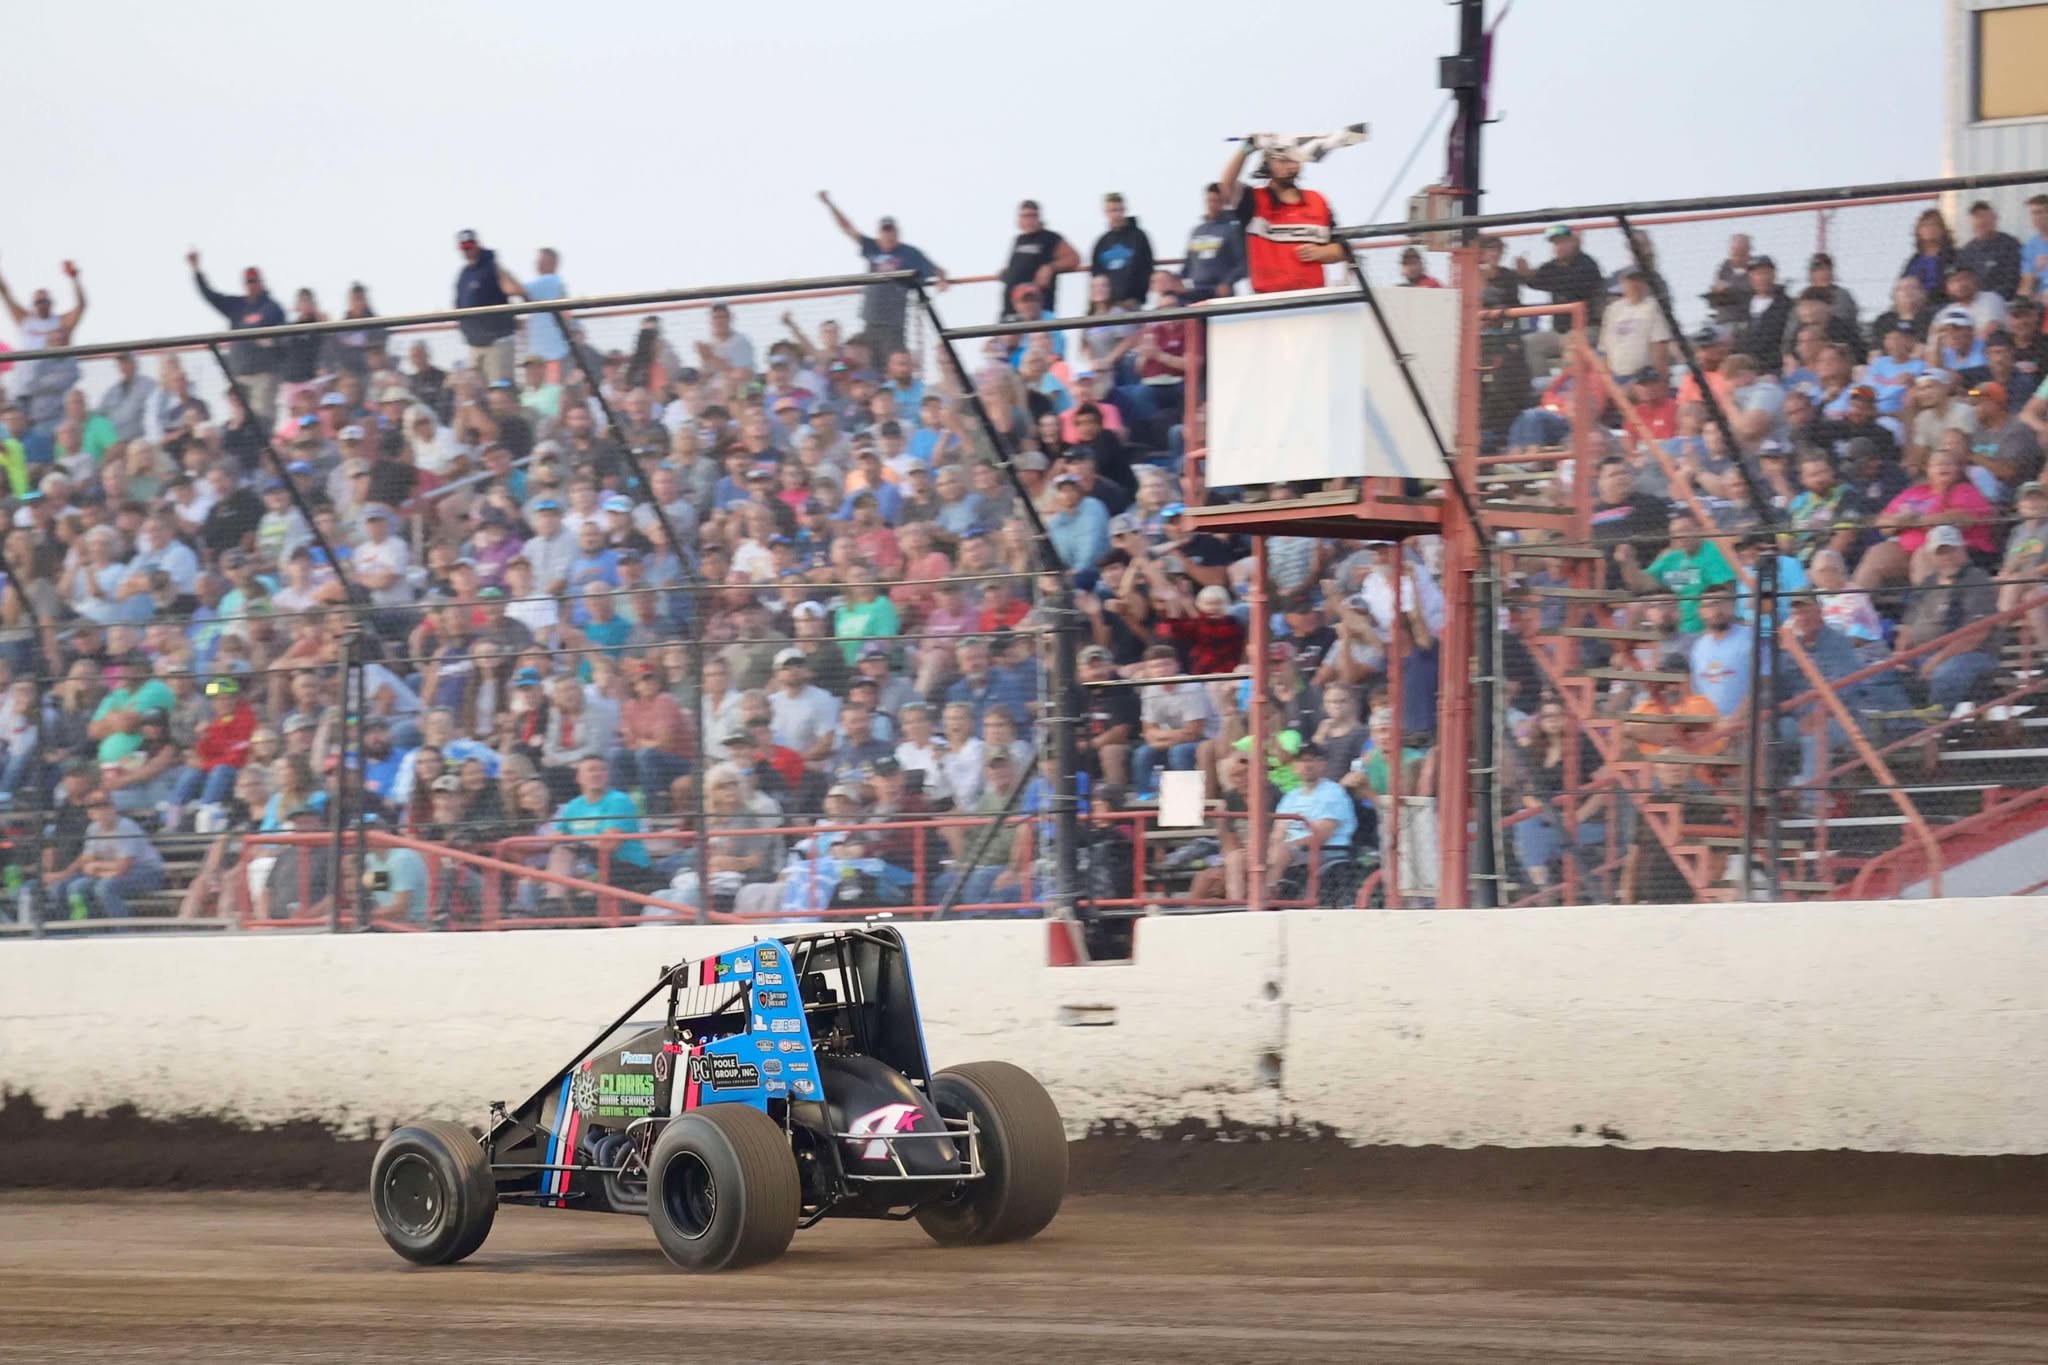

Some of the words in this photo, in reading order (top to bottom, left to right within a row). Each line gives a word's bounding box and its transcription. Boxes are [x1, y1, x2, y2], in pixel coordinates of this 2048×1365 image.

[713, 1059, 736, 1068] POOLE
[691, 1060, 710, 1079] PG
[715, 1068, 741, 1078] GROUP,
[741, 1068, 758, 1077] INC.
[599, 1095, 620, 1106] HOME
[620, 1095, 655, 1106] SERVICES
[599, 1106, 625, 1116] HEATING
